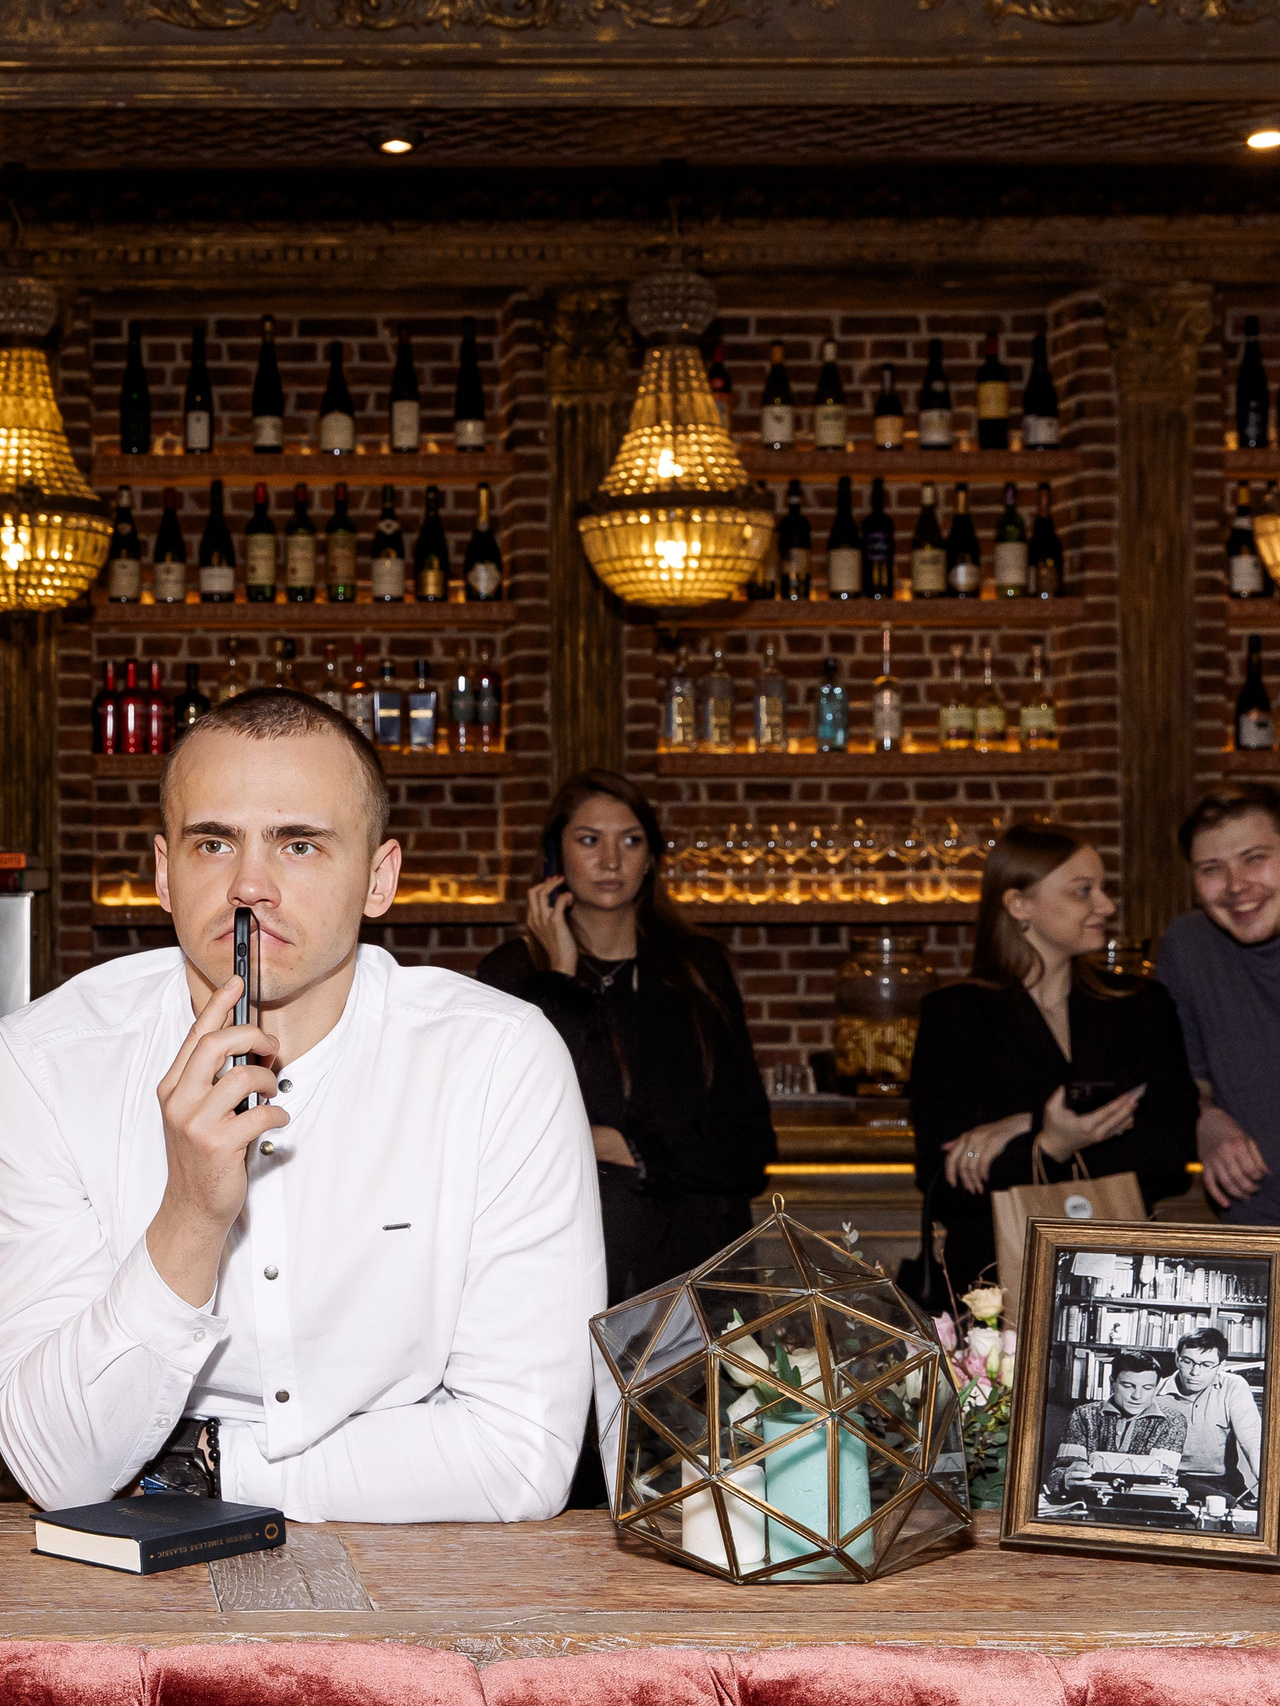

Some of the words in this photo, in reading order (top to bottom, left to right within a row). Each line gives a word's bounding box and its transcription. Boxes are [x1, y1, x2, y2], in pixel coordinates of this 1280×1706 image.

[226, 1533, 253, 1544] ONEGIN
[190, 1539, 224, 1551] TIMELESS
[157, 1547, 188, 1558] CLASSIC
